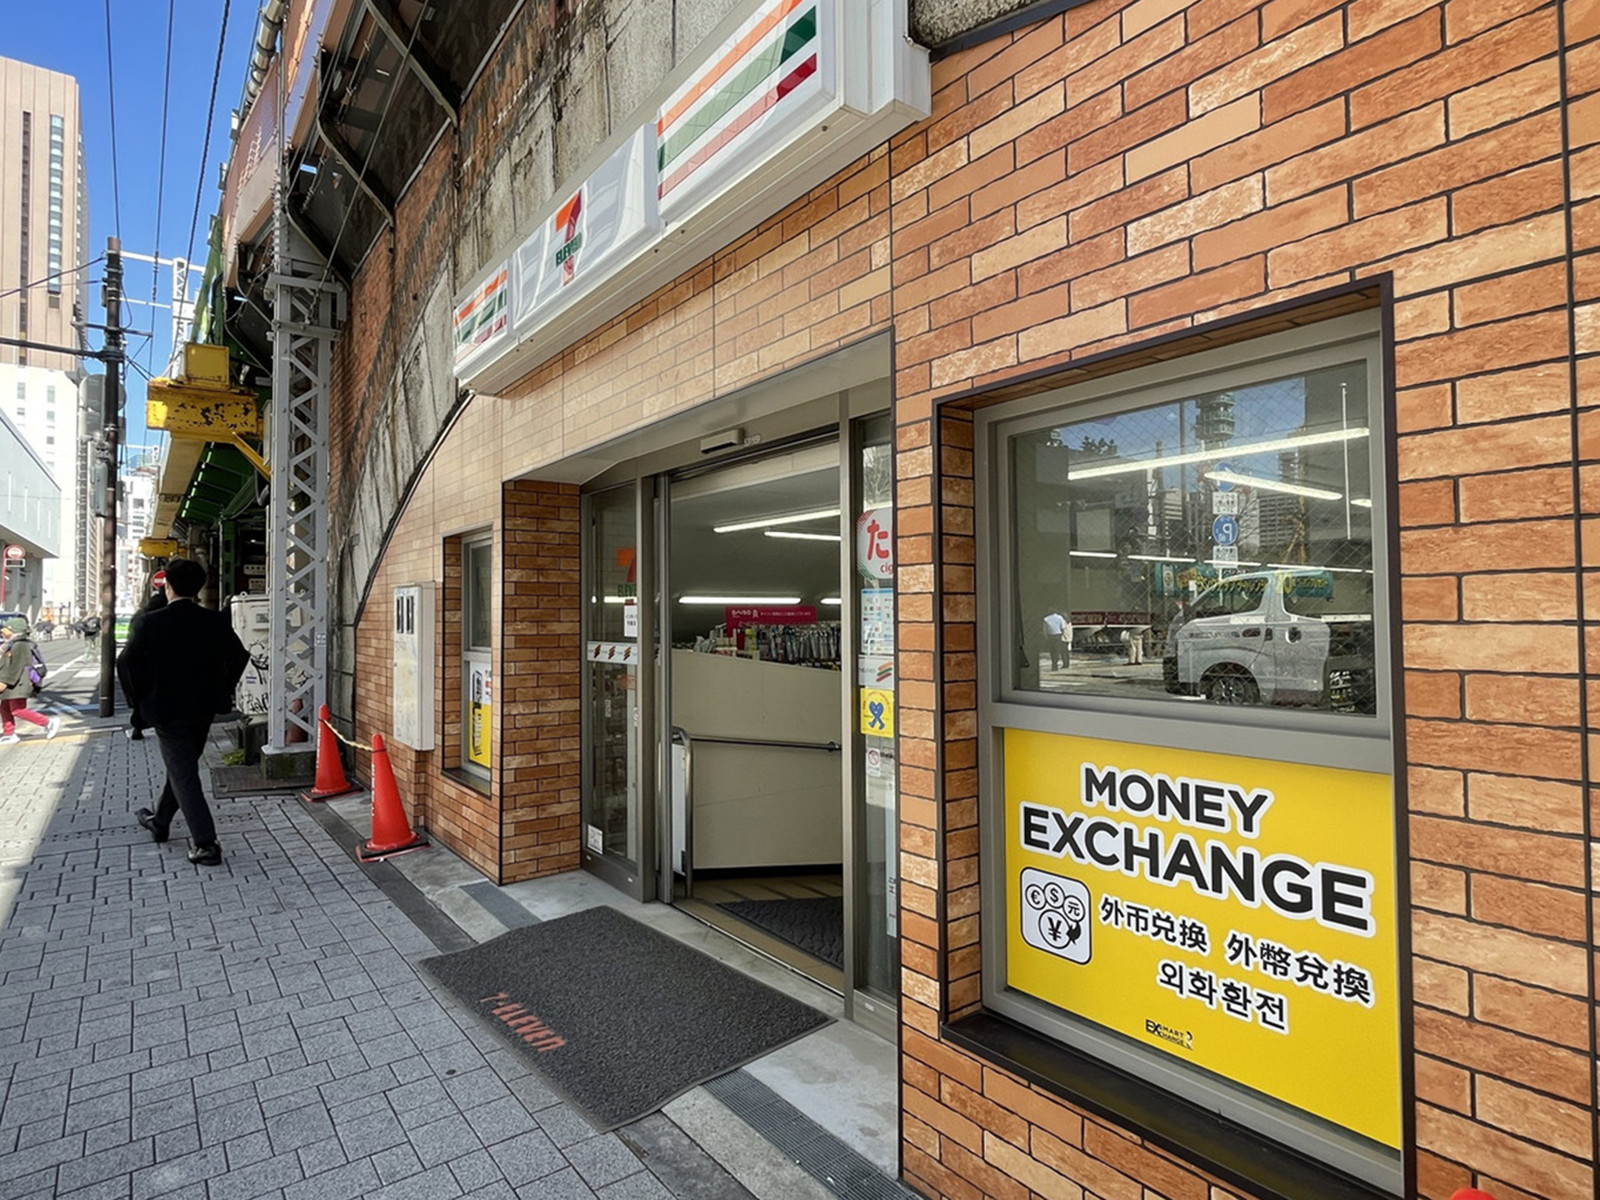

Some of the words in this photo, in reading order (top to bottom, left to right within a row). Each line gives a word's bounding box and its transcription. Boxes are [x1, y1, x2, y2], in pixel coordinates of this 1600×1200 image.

[1084, 767, 1268, 832] MONEY
[1023, 806, 1369, 931] EXCHANGE
[1158, 963, 1287, 1030] 외화환전
